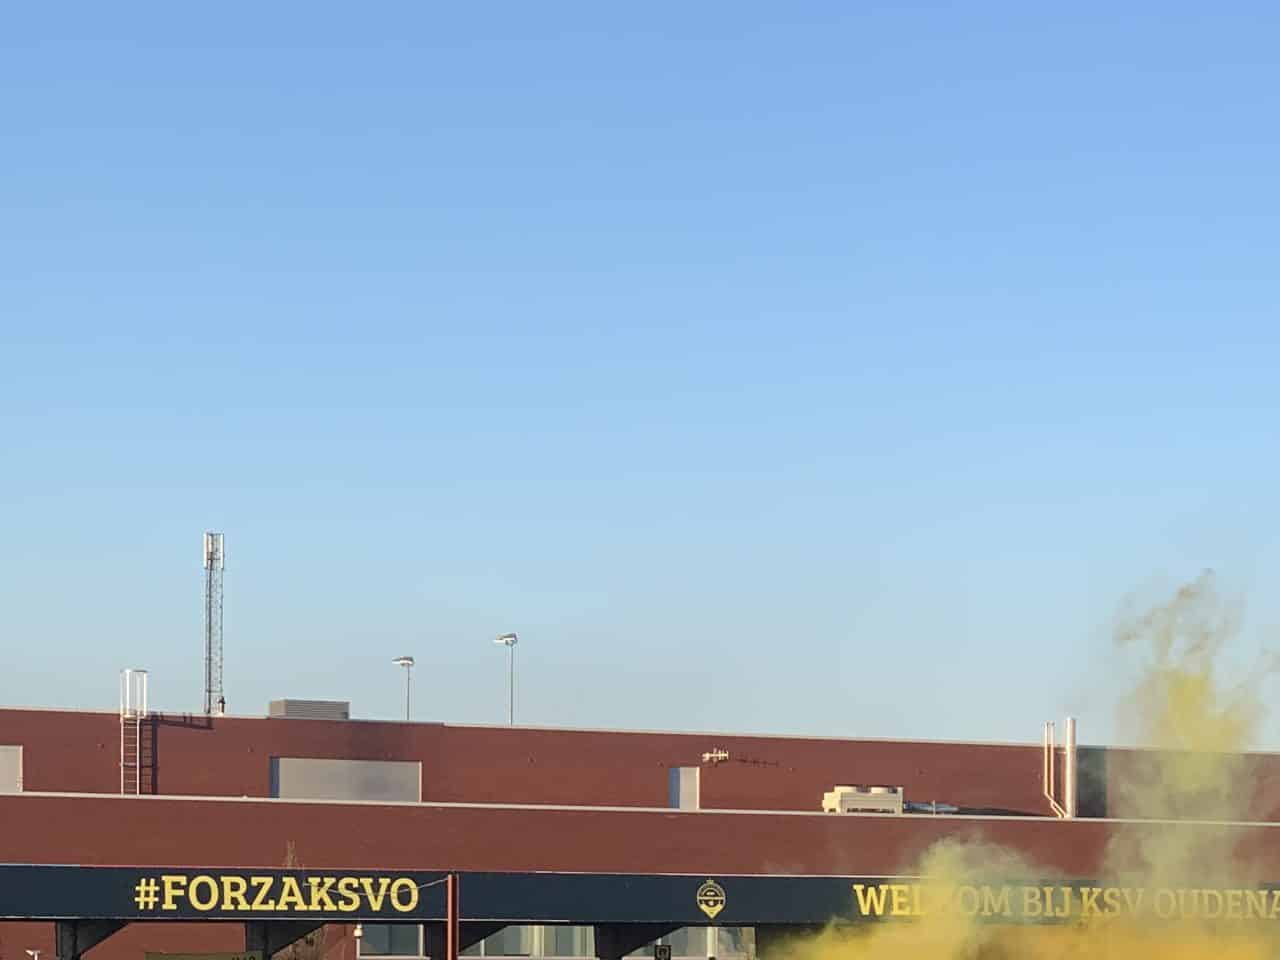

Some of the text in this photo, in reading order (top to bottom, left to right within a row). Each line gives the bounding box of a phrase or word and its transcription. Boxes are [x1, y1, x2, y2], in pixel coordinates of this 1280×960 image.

[134, 875, 419, 912] #FORZAKSVO
[853, 884, 1011, 916] WELOM
[1023, 886, 1073, 918] BIJ
[1079, 887, 1145, 919] KSV
